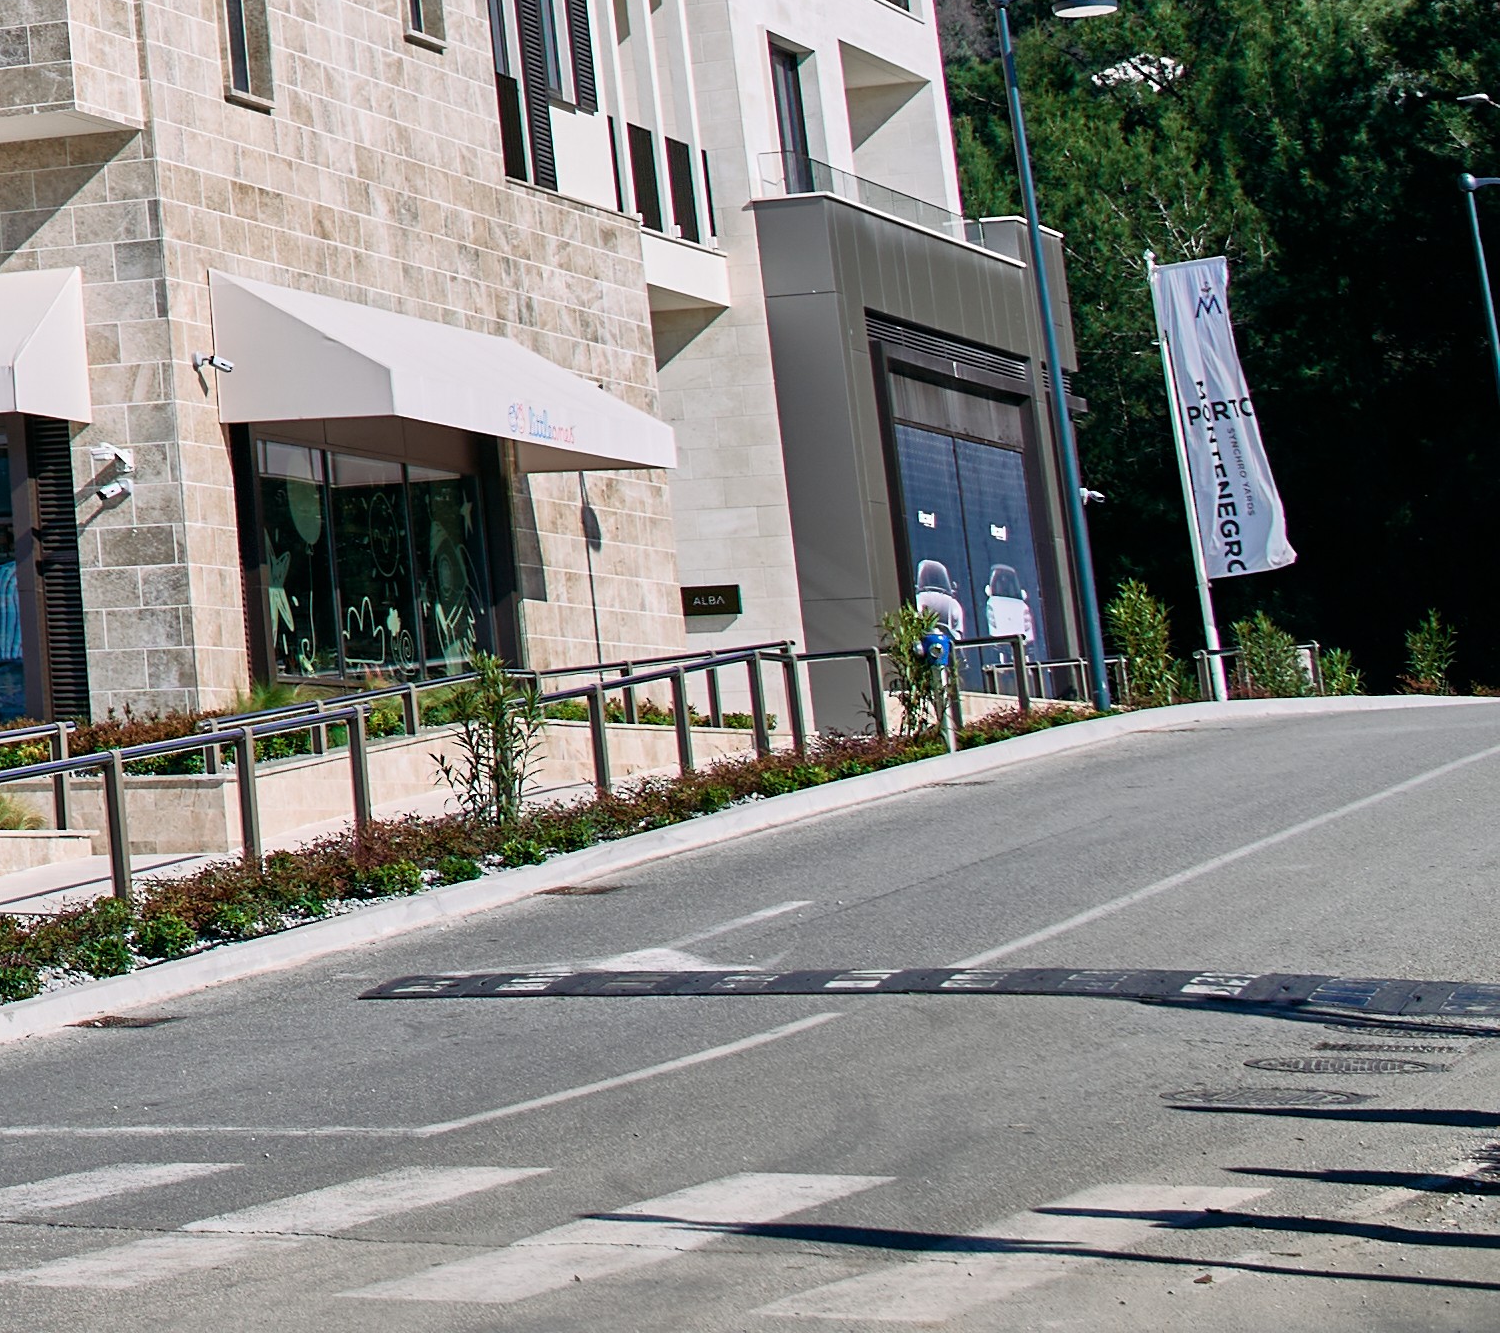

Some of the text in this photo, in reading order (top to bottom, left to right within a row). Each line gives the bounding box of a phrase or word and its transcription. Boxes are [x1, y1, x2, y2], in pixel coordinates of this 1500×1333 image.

[1227, 427, 1255, 517] SYNCHRO YARDS
[692, 595, 726, 606] ALBA
